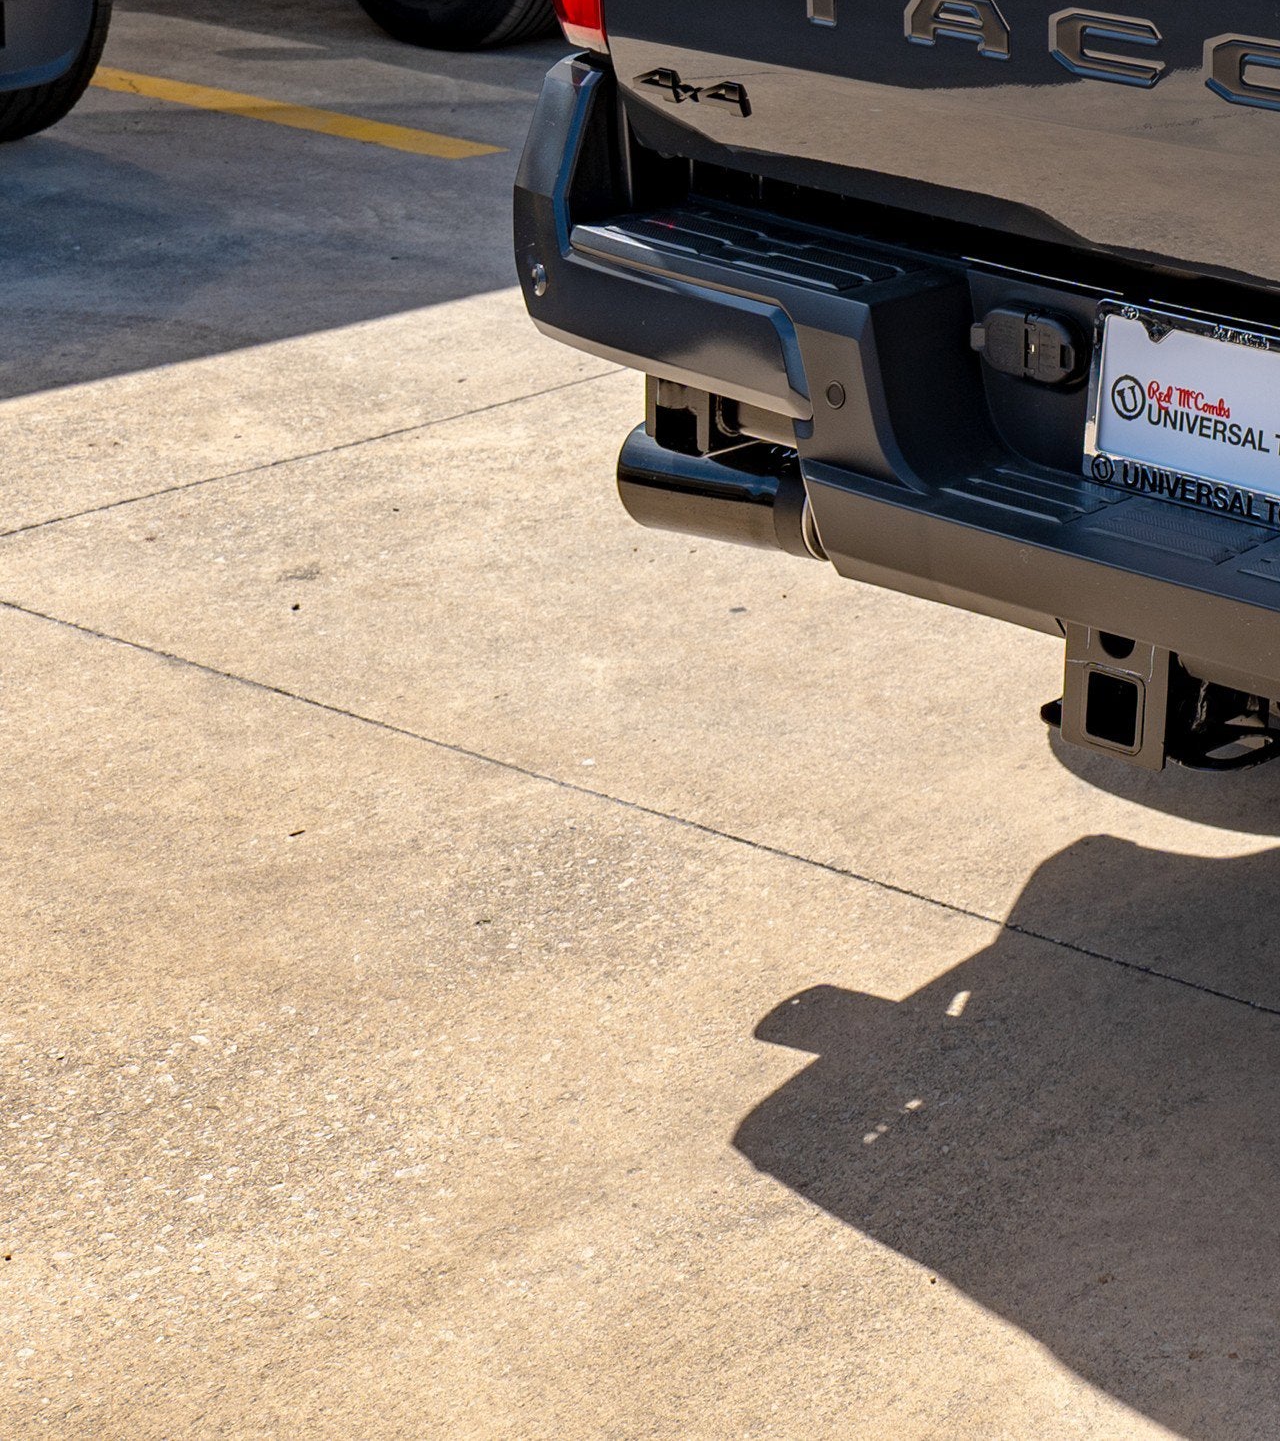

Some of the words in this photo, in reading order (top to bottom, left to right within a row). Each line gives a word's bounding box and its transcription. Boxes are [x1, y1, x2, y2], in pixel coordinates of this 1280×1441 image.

[1147, 380, 1174, 410] Red
[1177, 386, 1231, 420] McCombs
[1147, 403, 1270, 454] UNIVERSAL
[1121, 460, 1261, 519] UNIVERSAL
